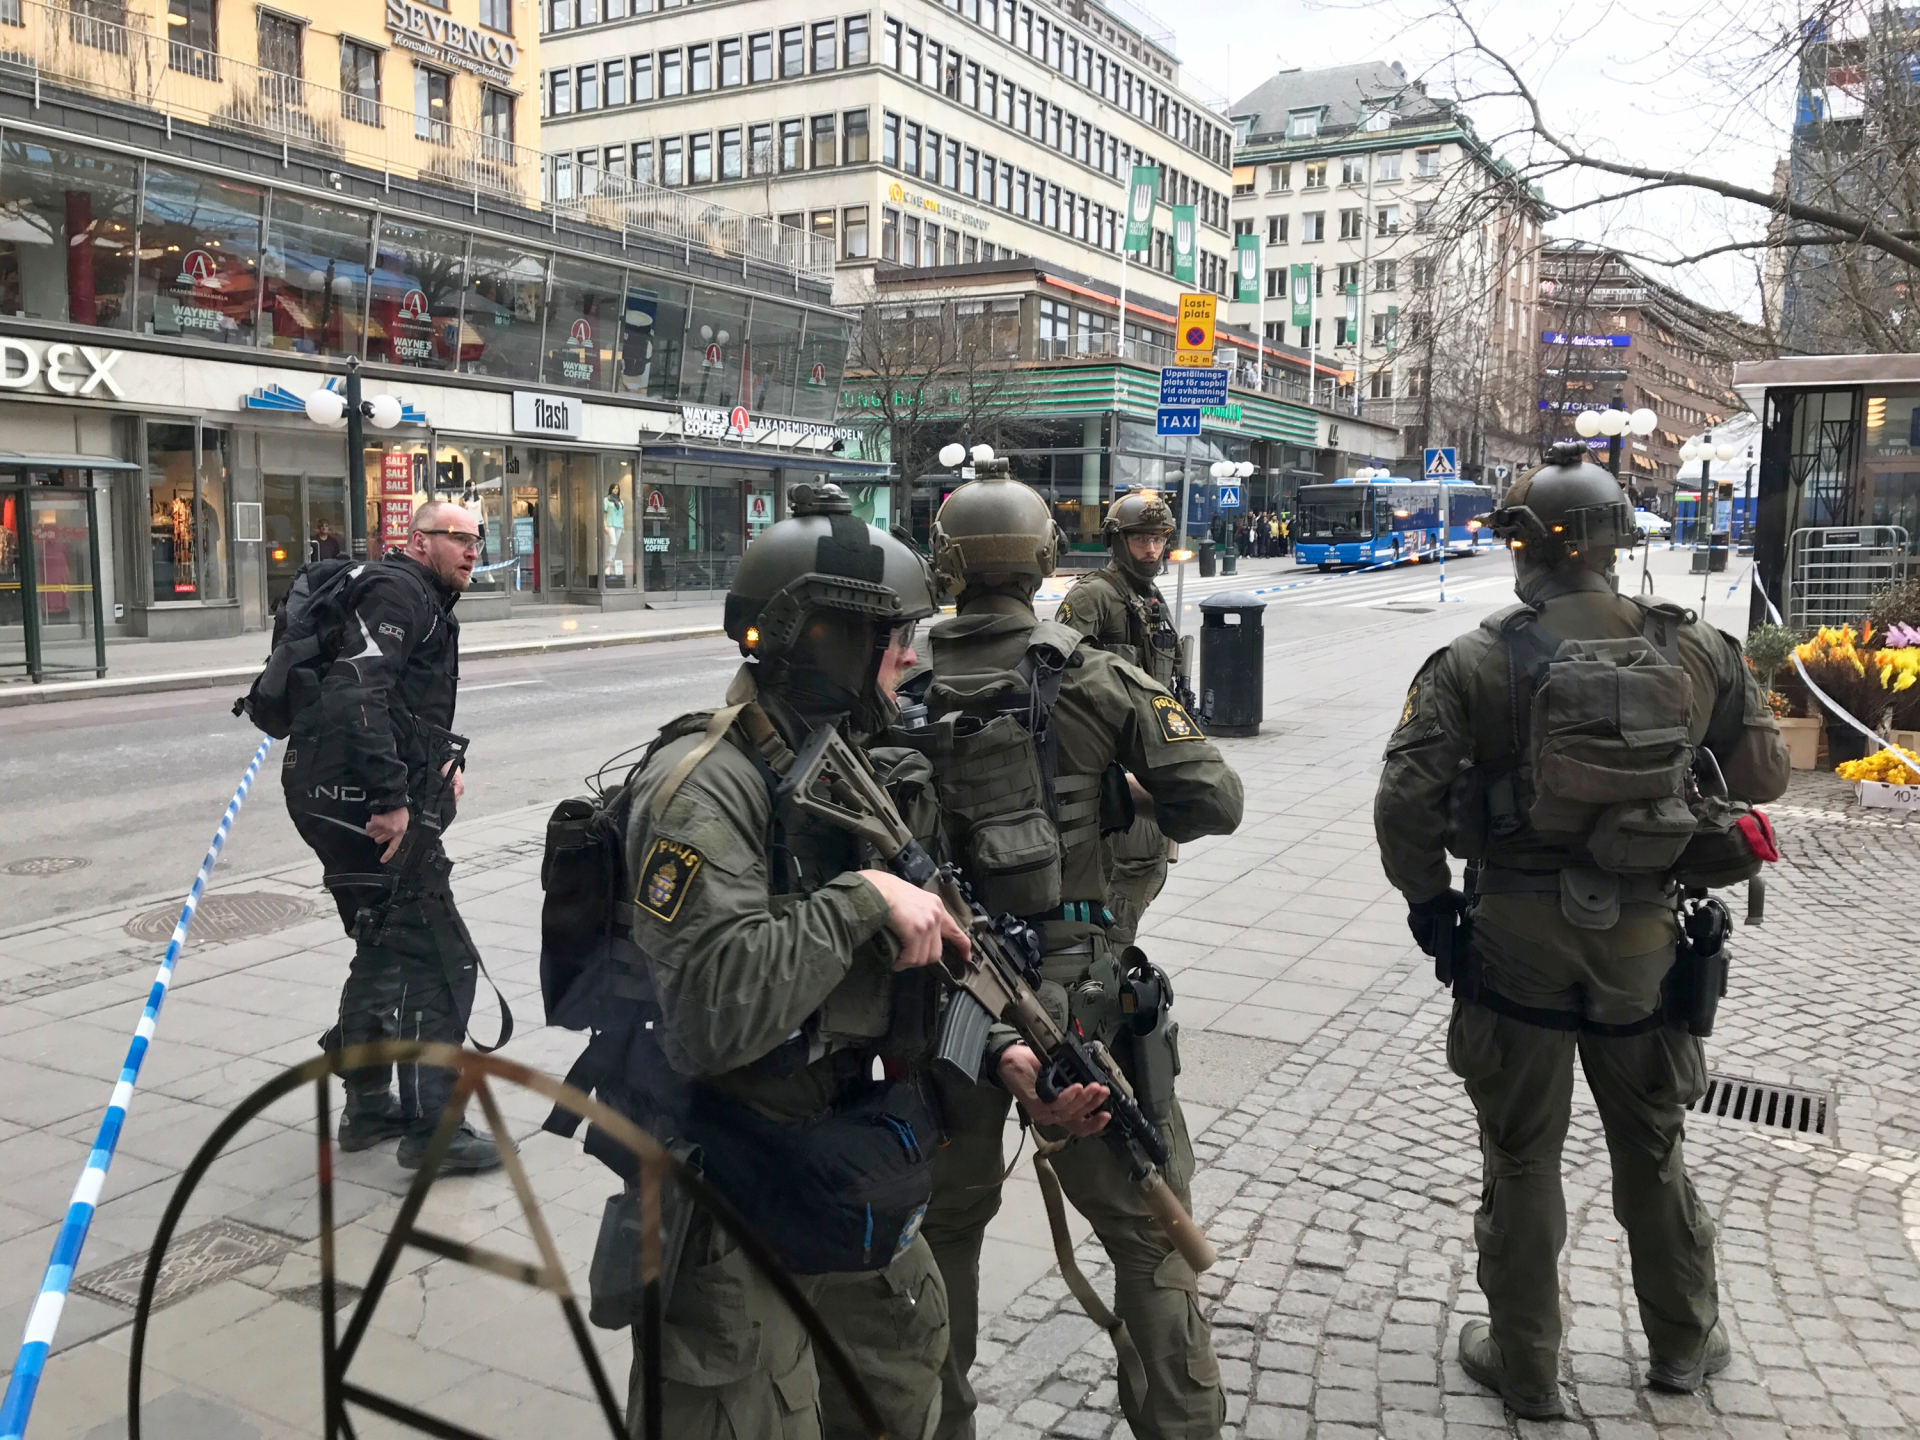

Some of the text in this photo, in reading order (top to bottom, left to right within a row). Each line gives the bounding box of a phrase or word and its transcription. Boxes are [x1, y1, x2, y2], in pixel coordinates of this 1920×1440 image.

[386, 0, 518, 68] SEVENCO
[394, 33, 440, 58] Konsulter
[172, 304, 224, 320] WAYNE'S
[1184, 309, 1210, 319] plats
[175, 315, 220, 331] COFFEE
[393, 336, 432, 350] WAYNE'S
[395, 346, 429, 358] COFFEE
[1179, 355, 1198, 363] 0-12
[563, 361, 594, 372] WAYNE'S
[564, 369, 591, 380] COFFEE
[1166, 370, 1225, 379] Uppställnings-
[1163, 378, 1225, 388] plats för sopbil
[1178, 387, 1225, 396] avhämtning
[535, 398, 568, 430] flash
[682, 406, 729, 423] WAYNE'S
[1161, 415, 1197, 428] TAXI
[685, 420, 728, 437] COFFEE
[757, 418, 863, 441] AKADEMIBOKHANDELN
[385, 456, 407, 466] SALE
[386, 468, 408, 478] SALE
[386, 480, 408, 490] SALE
[386, 502, 408, 511] SALE
[387, 514, 408, 524] SALE
[387, 526, 408, 536] SALE
[644, 537, 670, 545] WAYNE'S
[645, 544, 669, 552] COFFEE
[1154, 698, 1182, 712] POLIS
[658, 840, 698, 867] POLIS
